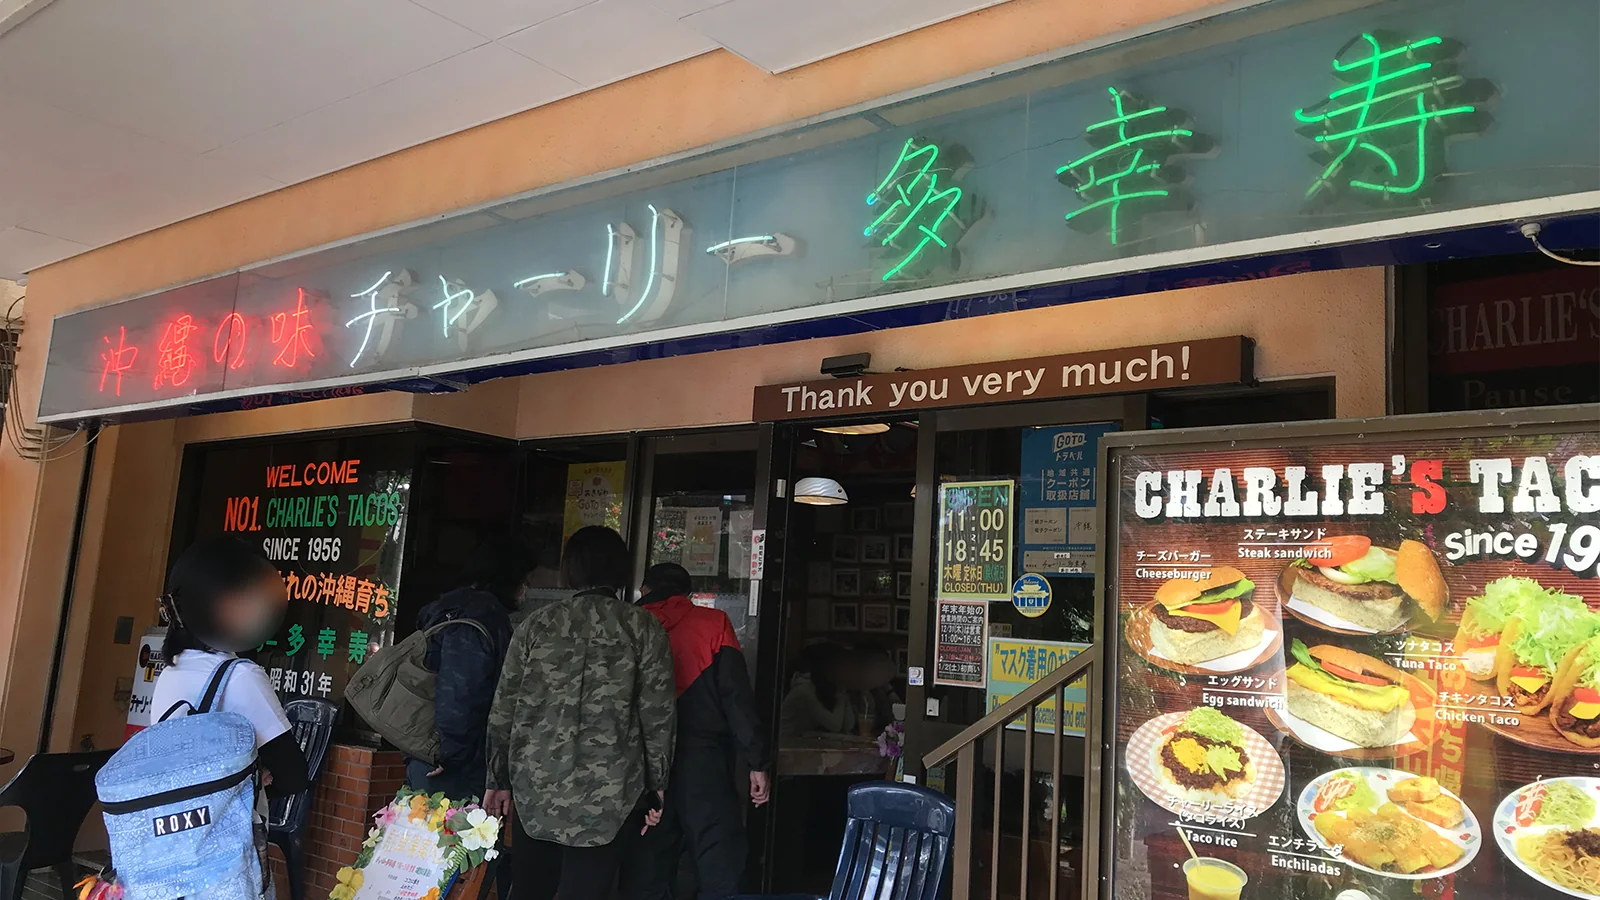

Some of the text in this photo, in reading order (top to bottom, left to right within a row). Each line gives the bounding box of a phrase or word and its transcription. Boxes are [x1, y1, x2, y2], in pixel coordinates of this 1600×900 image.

[98, 286, 316, 397] 沖縄の味
[781, 345, 1191, 413] Thank you very much!
[1463, 380, 1573, 408] Pause
[1055, 451, 1084, 462] トラベル
[266, 459, 361, 488] WELCOME
[1046, 478, 1091, 489] クーポン
[945, 486, 1009, 508] OPEN
[1046, 489, 1091, 501] 取扱店舗
[1134, 454, 1448, 520] CHARLIE'S
[223, 491, 401, 532] NO1. CHARLIE'S TACOS
[946, 508, 1005, 532] 11:00
[1242, 527, 1327, 541] ステーキサンド
[262, 536, 342, 561] SINCE 1956
[945, 539, 1004, 562] 18:45
[1135, 548, 1213, 563] チーズバーガー
[1238, 546, 1333, 559] Steak sandwich
[1444, 522, 1600, 578] Since 19
[1135, 567, 1213, 581] Cheeseburger
[278, 570, 390, 619] れの沖縄育ち
[941, 604, 984, 615] 年末年始の
[1394, 639, 1456, 654] ツナタコス
[1394, 656, 1457, 672] Tuna Taco
[1207, 675, 1279, 690] エッグサンド
[1202, 693, 1285, 710] Egg sandwich
[1437, 690, 1516, 708] チキンタコス
[1434, 708, 1520, 727] Chicken Taco
[1167, 796, 1260, 819] チャーリーライス
[155, 807, 209, 837] ROXY
[1185, 829, 1238, 848] Taco rice
[1268, 834, 1345, 857] エンチラーダ
[1271, 855, 1341, 877] Enchiladas
